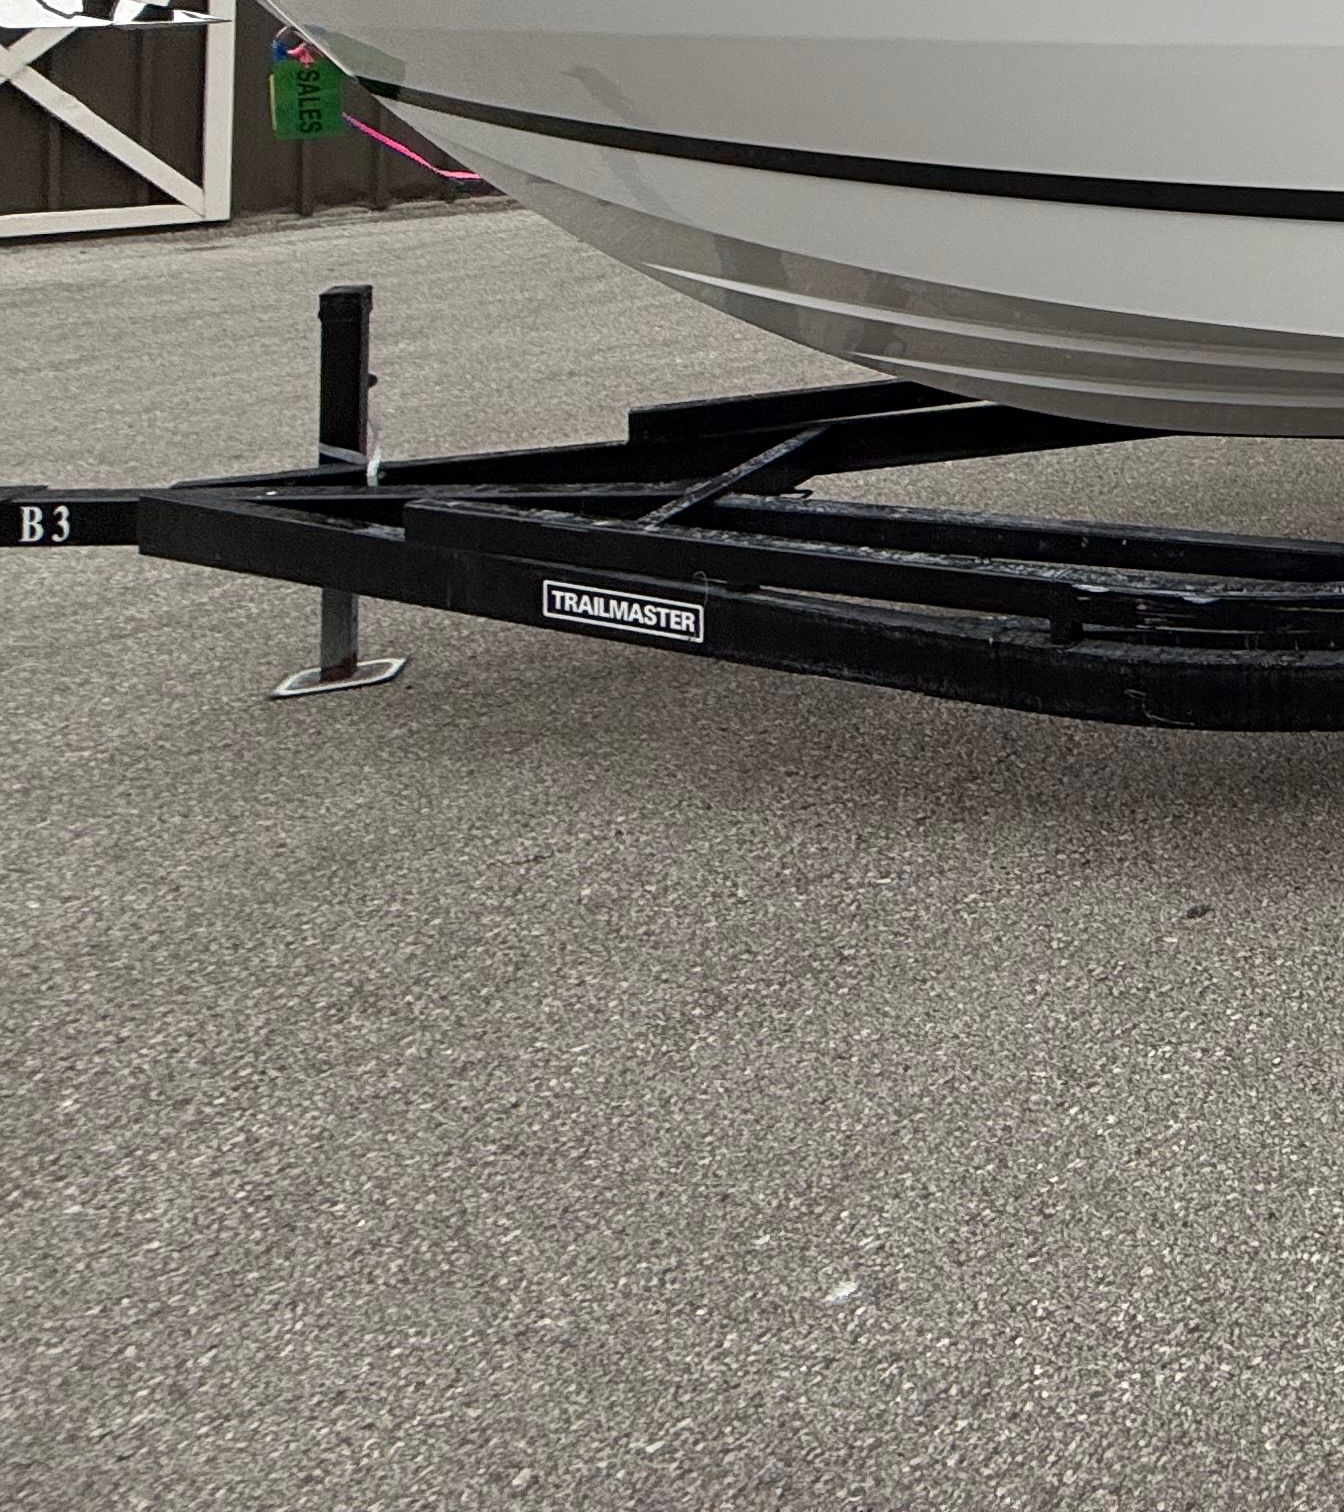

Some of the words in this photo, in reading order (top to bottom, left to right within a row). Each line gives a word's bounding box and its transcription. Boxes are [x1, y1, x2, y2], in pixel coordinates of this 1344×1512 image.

[297, 69, 322, 133] SALES
[17, 506, 45, 542] B
[51, 505, 71, 542] 3
[551, 590, 696, 632] TRAILMASTER
